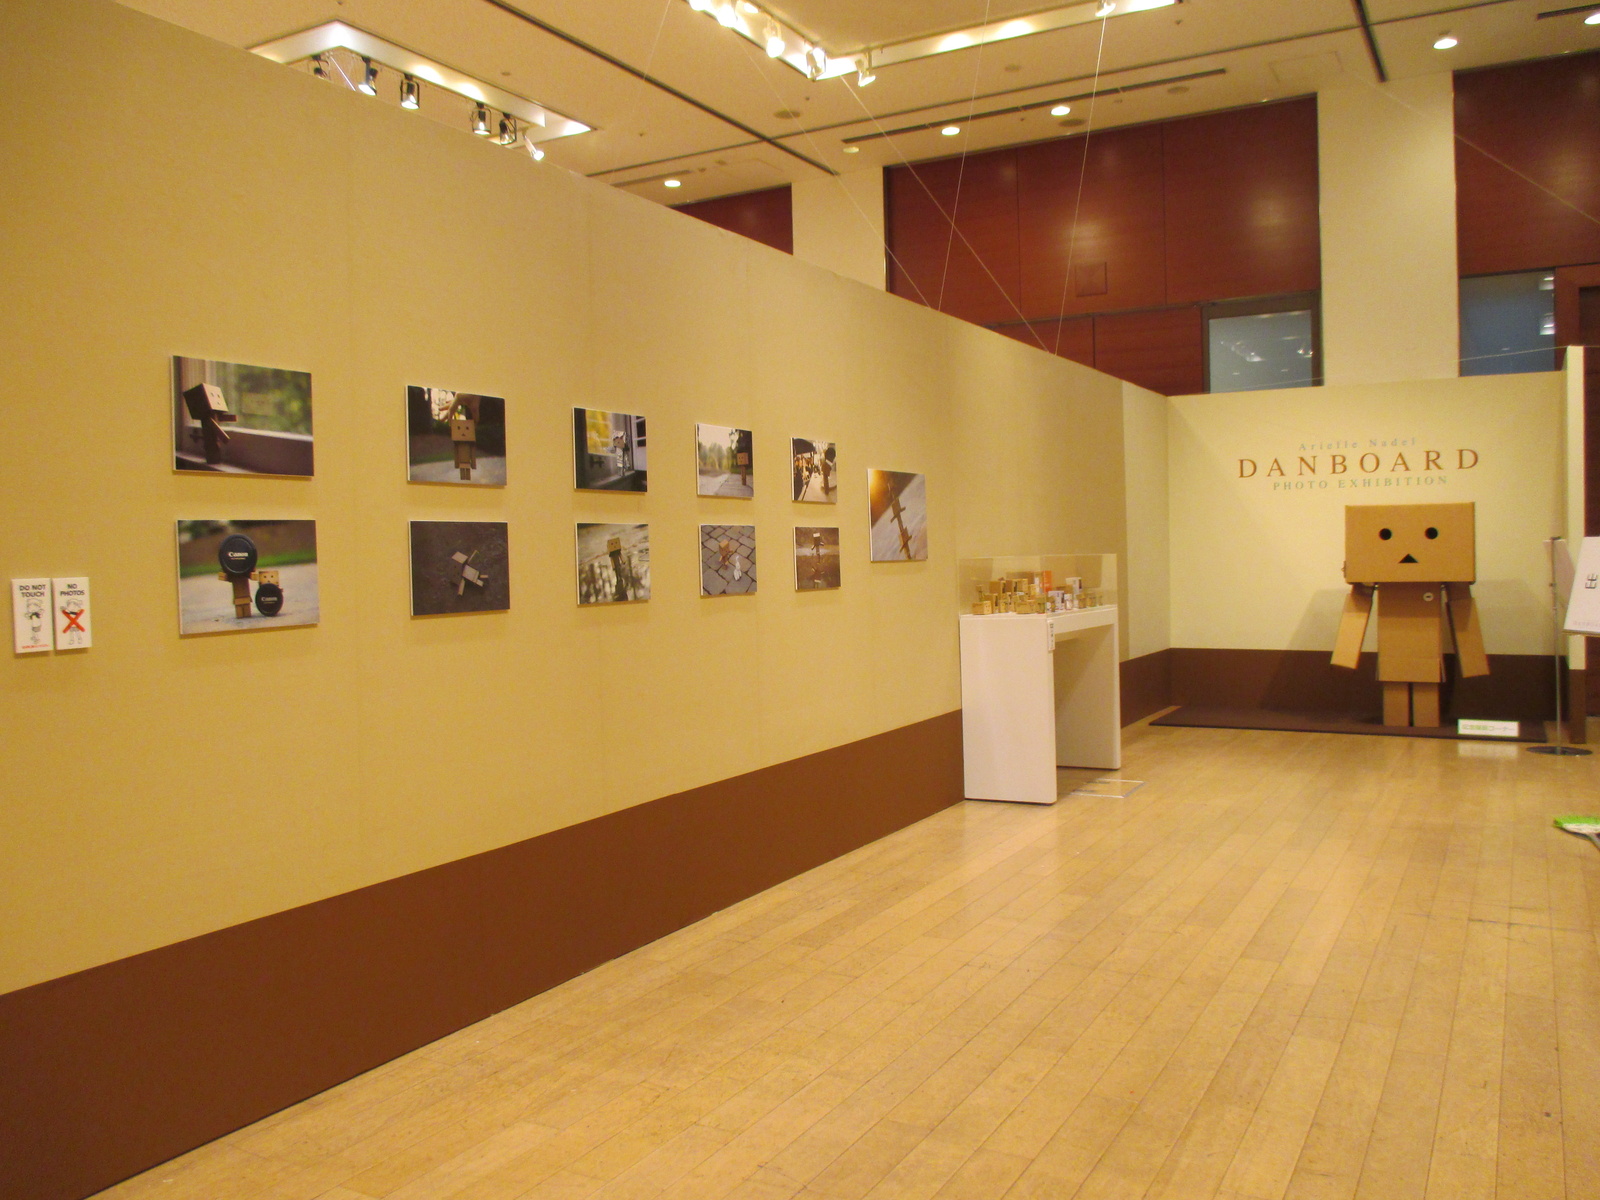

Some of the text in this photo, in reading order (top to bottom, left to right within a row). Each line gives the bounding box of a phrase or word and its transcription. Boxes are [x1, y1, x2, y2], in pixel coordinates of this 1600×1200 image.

[1238, 448, 1479, 478] DANBOARD
[1273, 475, 1448, 491] PHOTO EXHIBITION
